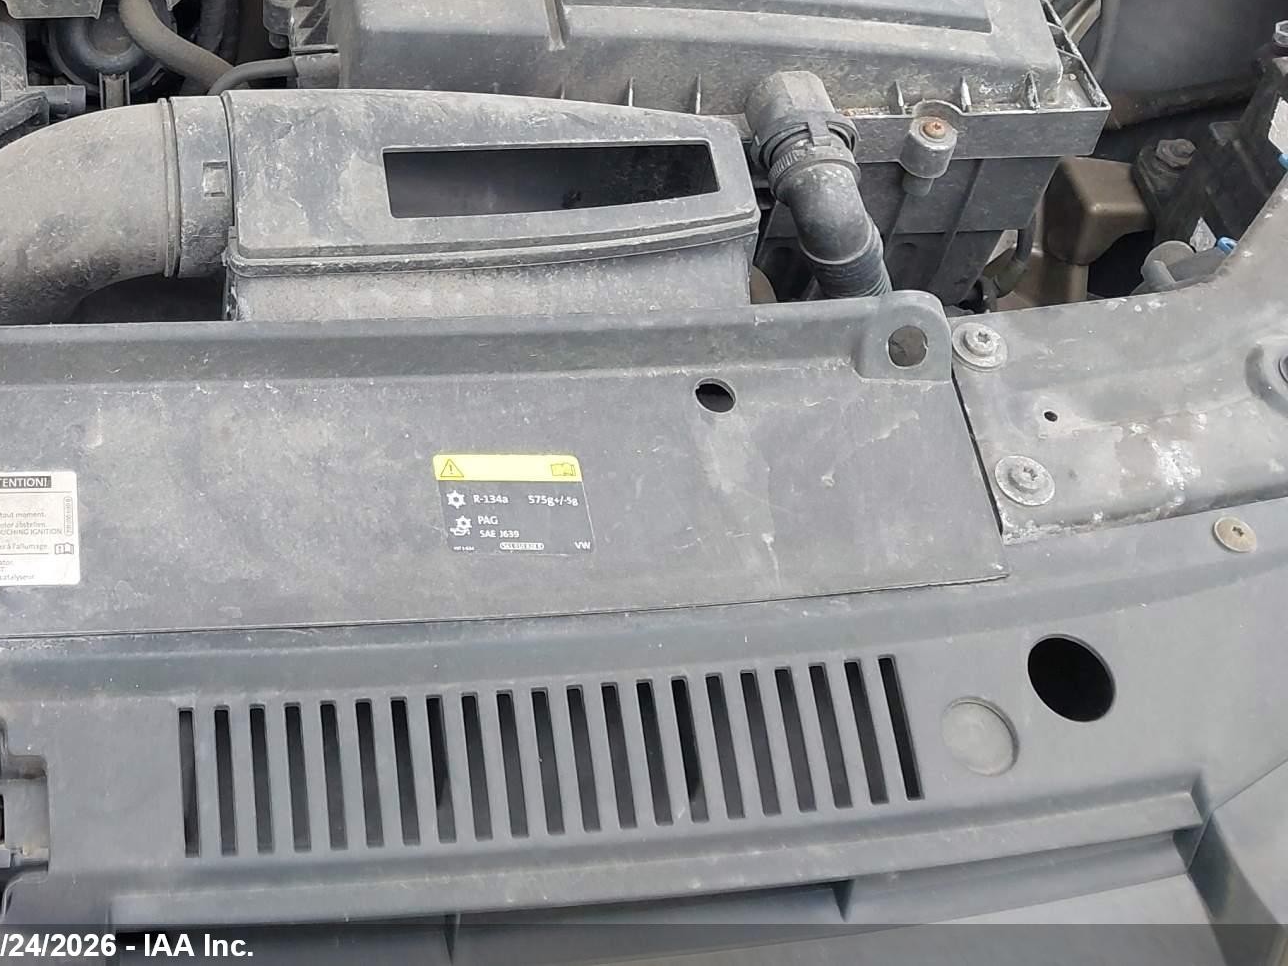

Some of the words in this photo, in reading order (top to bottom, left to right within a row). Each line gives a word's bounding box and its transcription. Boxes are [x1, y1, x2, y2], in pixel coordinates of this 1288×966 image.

[472, 494, 509, 504] R-134a
[527, 494, 579, 507] 575g+/-5g
[477, 515, 499, 525] PAG
[479, 529, 497, 538] SAE
[574, 541, 591, 550] VW
